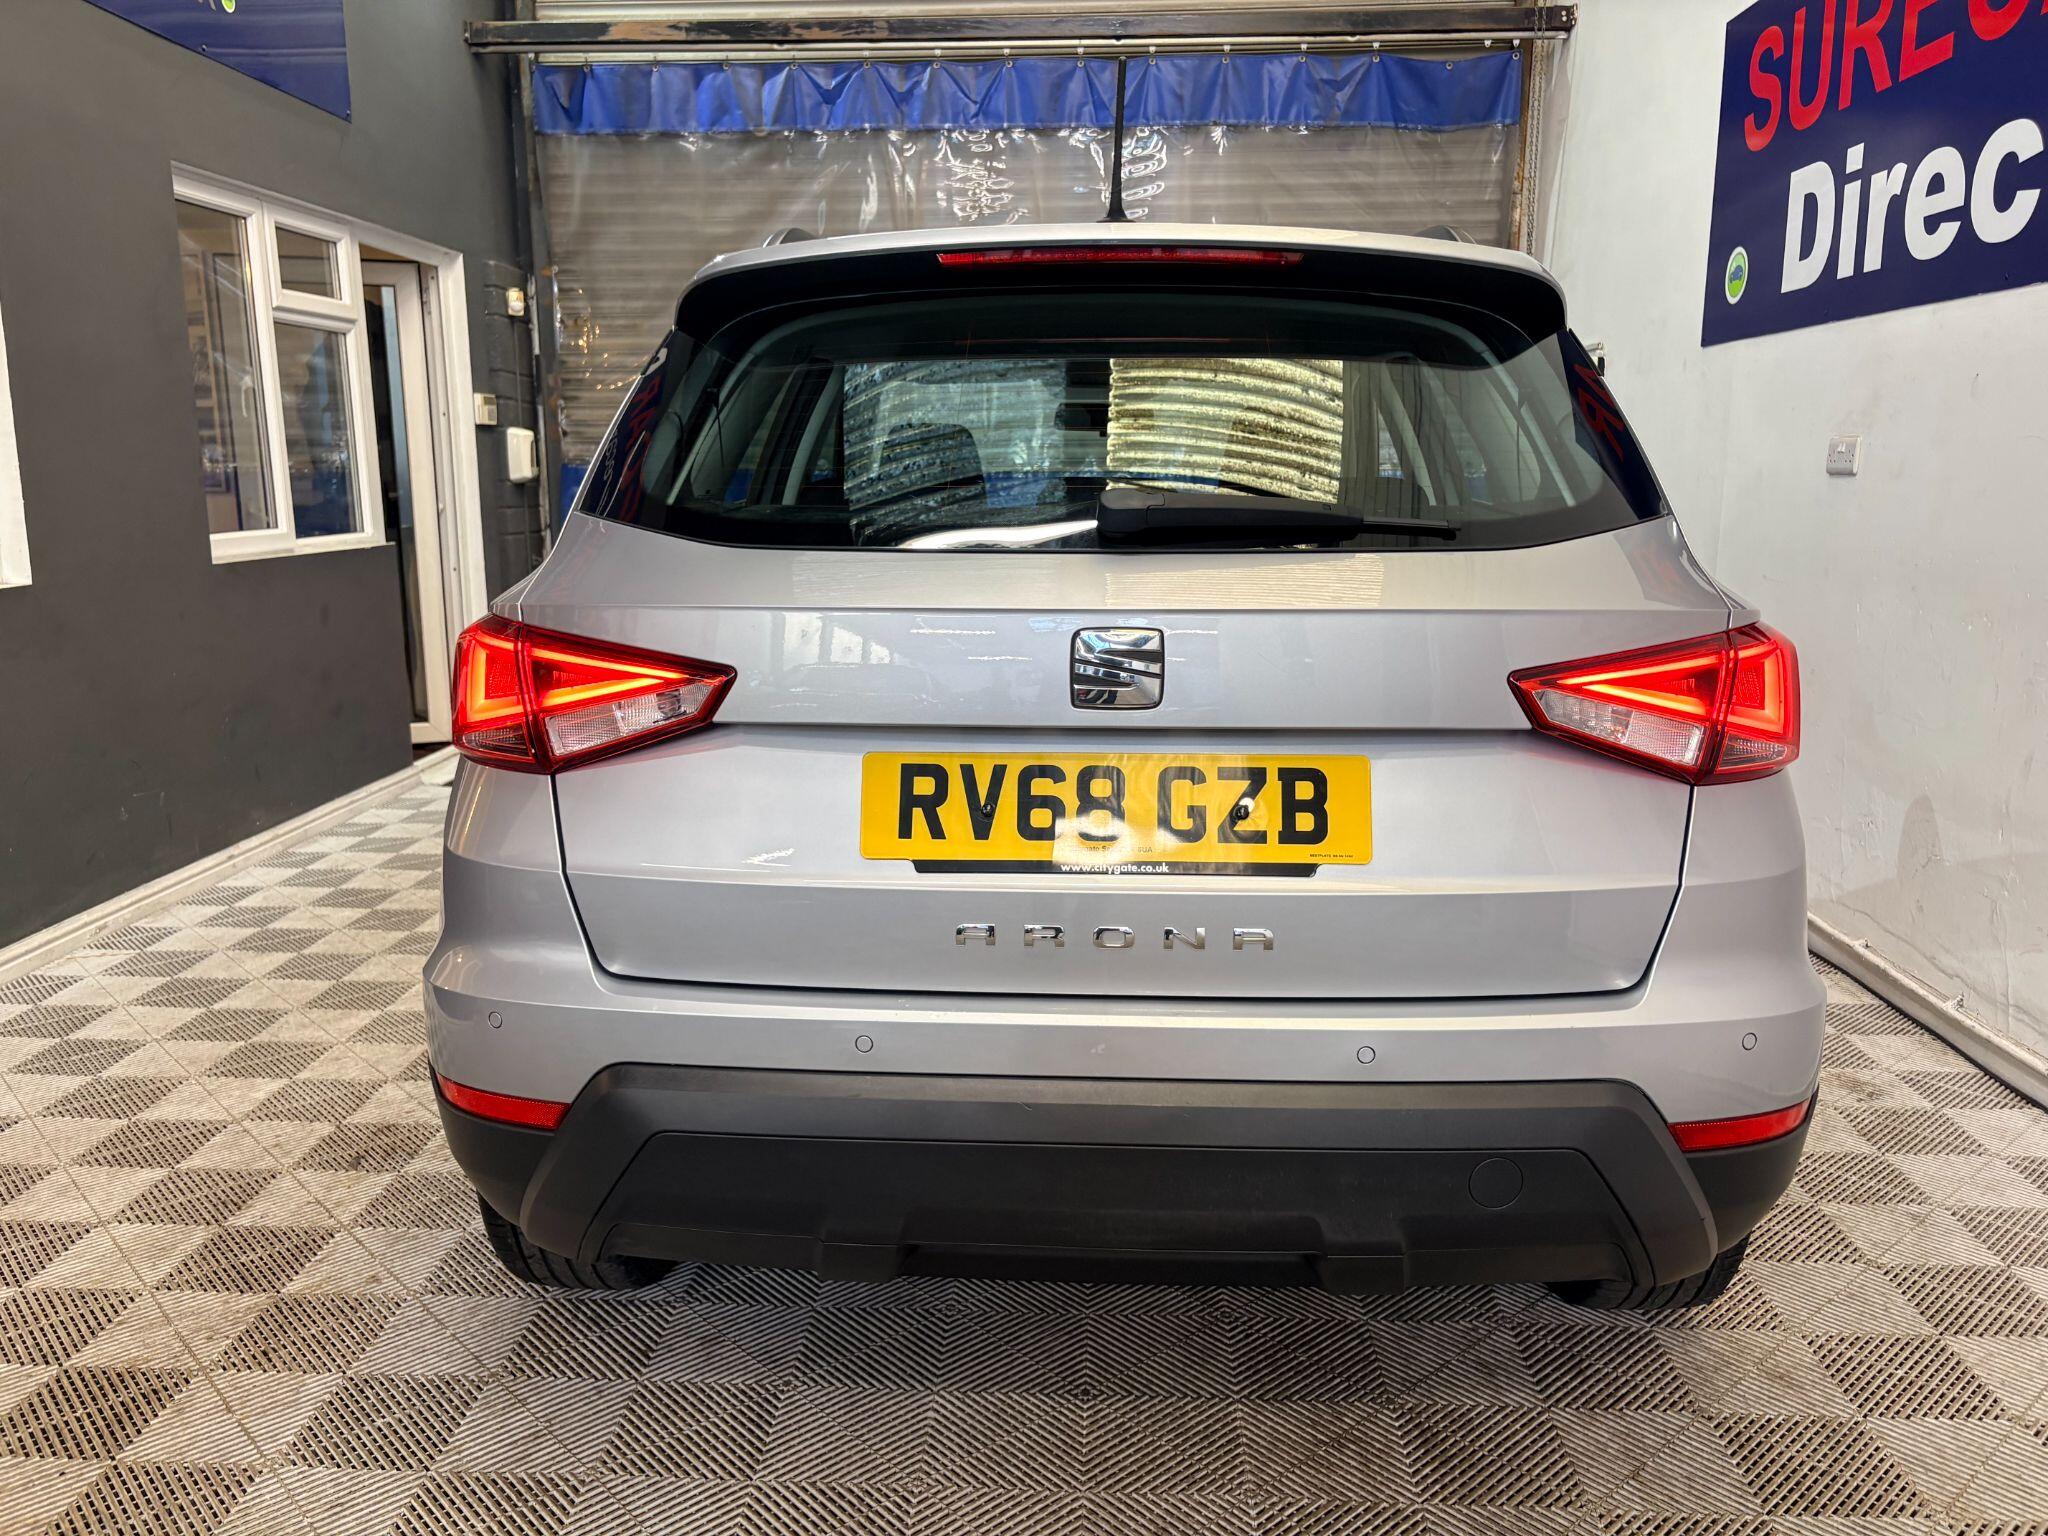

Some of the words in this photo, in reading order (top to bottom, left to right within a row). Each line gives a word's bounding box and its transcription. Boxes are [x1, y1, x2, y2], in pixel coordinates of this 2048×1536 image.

[1781, 118, 2044, 294] Direc
[899, 762, 1126, 842] RV68
[1156, 766, 1329, 846] GZB
[1060, 862, 1169, 874] www.citygate.co.uk
[955, 923, 1274, 951] ARONA
